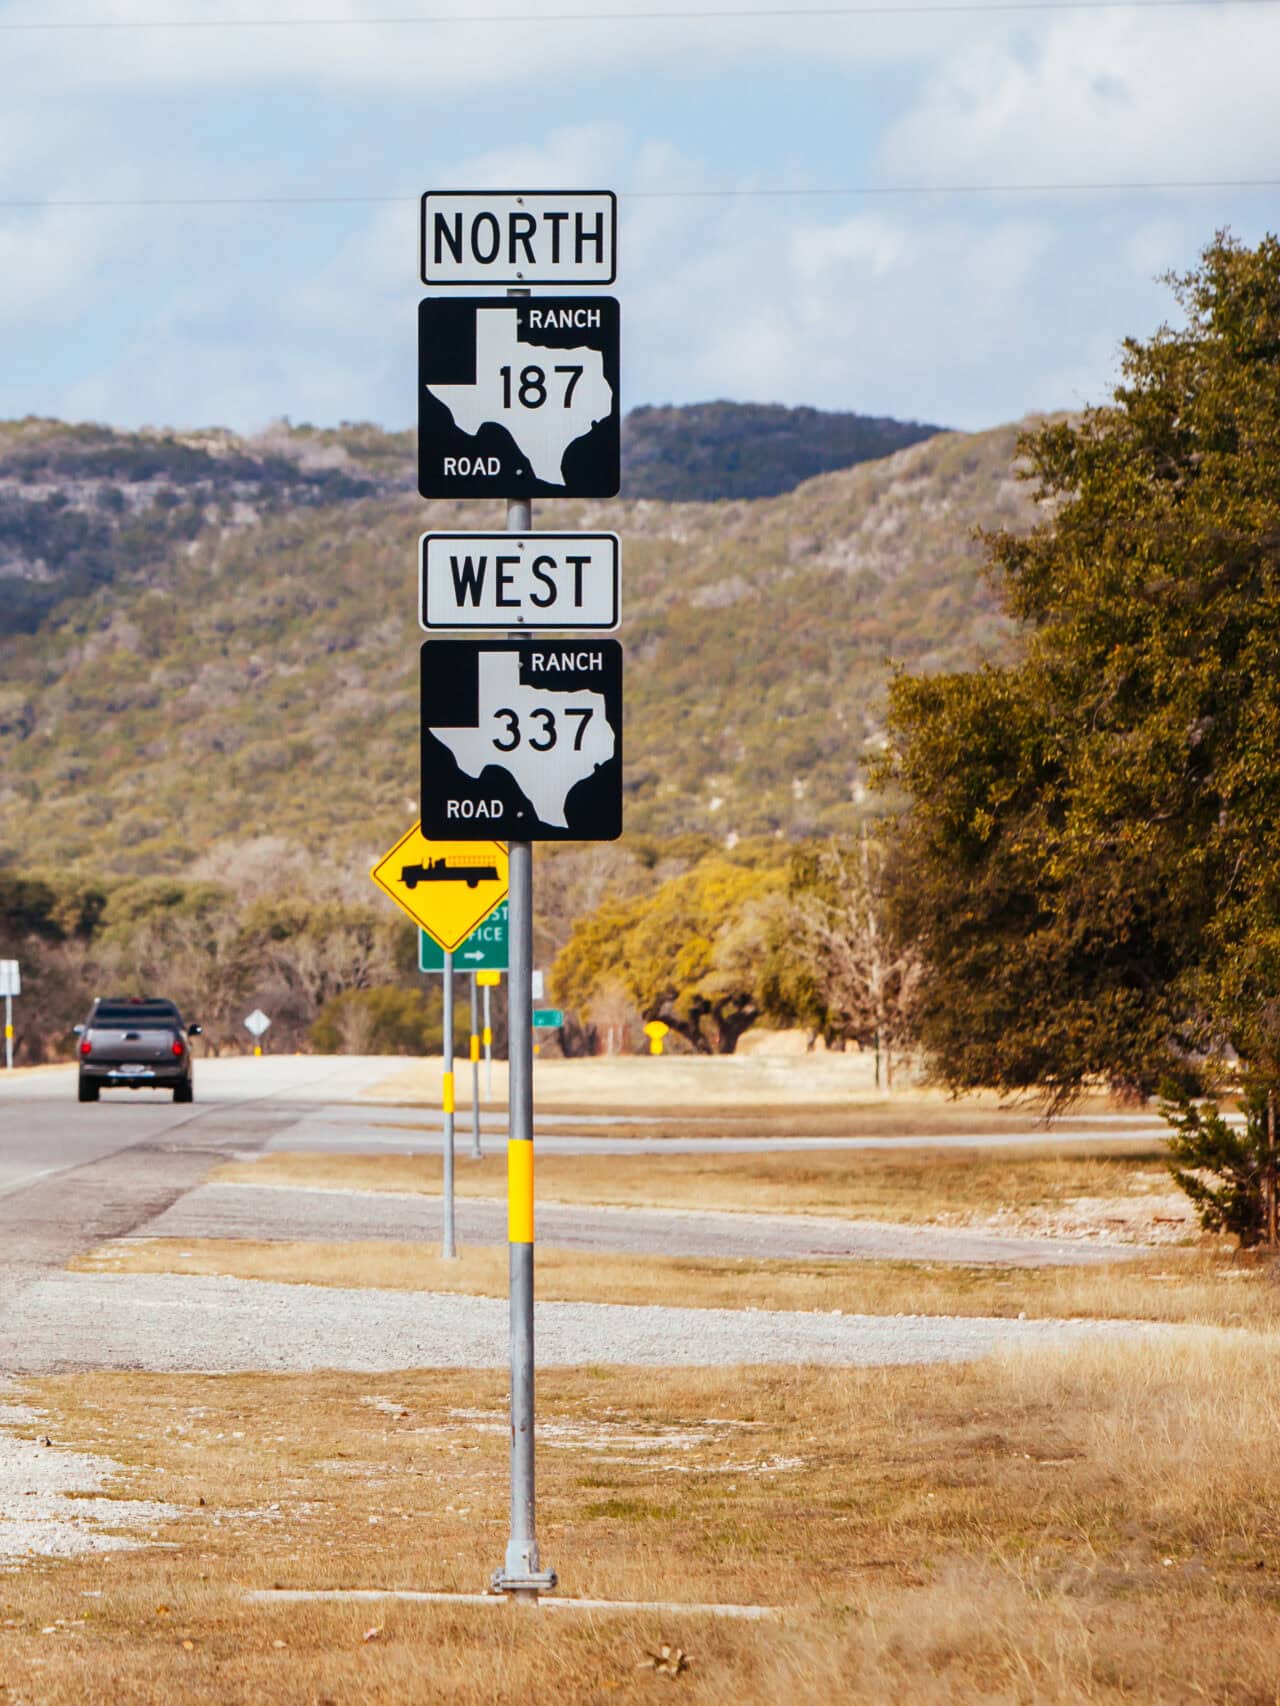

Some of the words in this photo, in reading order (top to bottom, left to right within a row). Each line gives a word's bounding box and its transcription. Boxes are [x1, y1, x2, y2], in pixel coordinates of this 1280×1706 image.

[433, 212, 603, 264] NORTH
[529, 310, 601, 329] RANCH
[500, 366, 583, 408] 187
[444, 457, 501, 476] ROAD
[450, 555, 592, 607] WEST
[531, 653, 603, 671] RANCH
[492, 708, 593, 751] 337
[446, 800, 504, 818] ROAD
